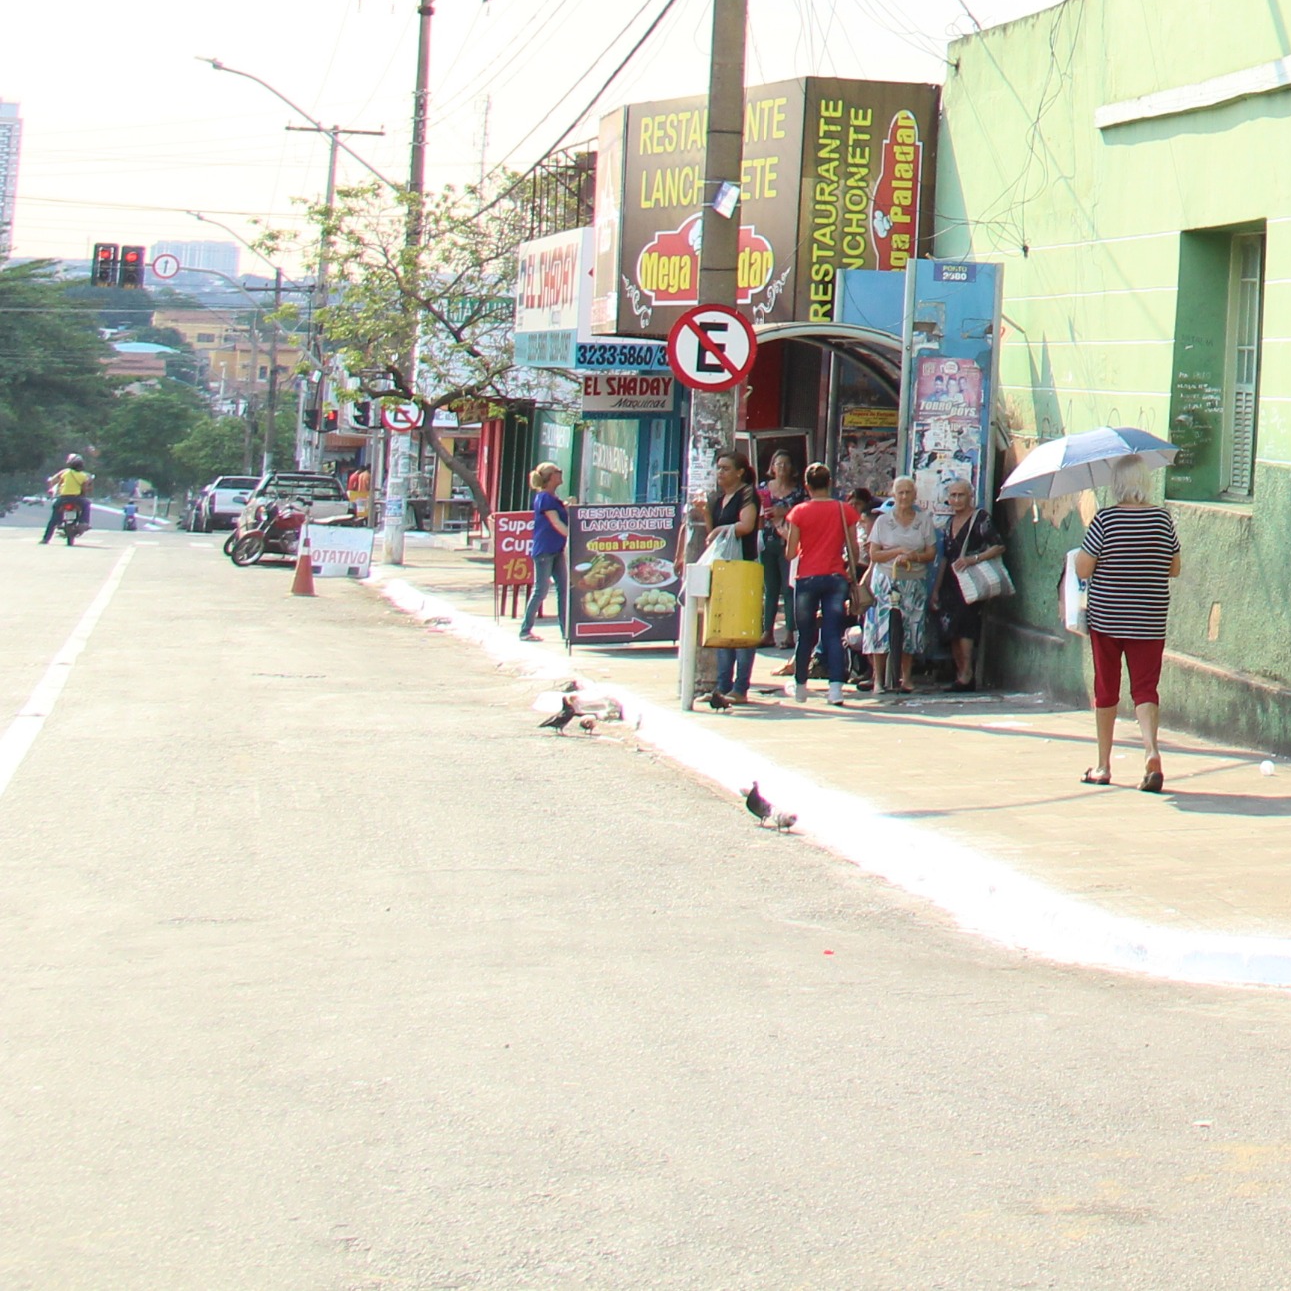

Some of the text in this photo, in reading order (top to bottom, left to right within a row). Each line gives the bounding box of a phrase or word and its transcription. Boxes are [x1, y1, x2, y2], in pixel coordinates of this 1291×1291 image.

[889, 110, 916, 224] Paladar
[809, 99, 844, 323] RESTAURANTE
[641, 251, 691, 294] Mega
[584, 376, 673, 397] EL SHADAY
[577, 506, 676, 519] RESTAURANTE
[581, 519, 673, 531] LANCHONETE
[587, 539, 667, 551] Mega Paladar
